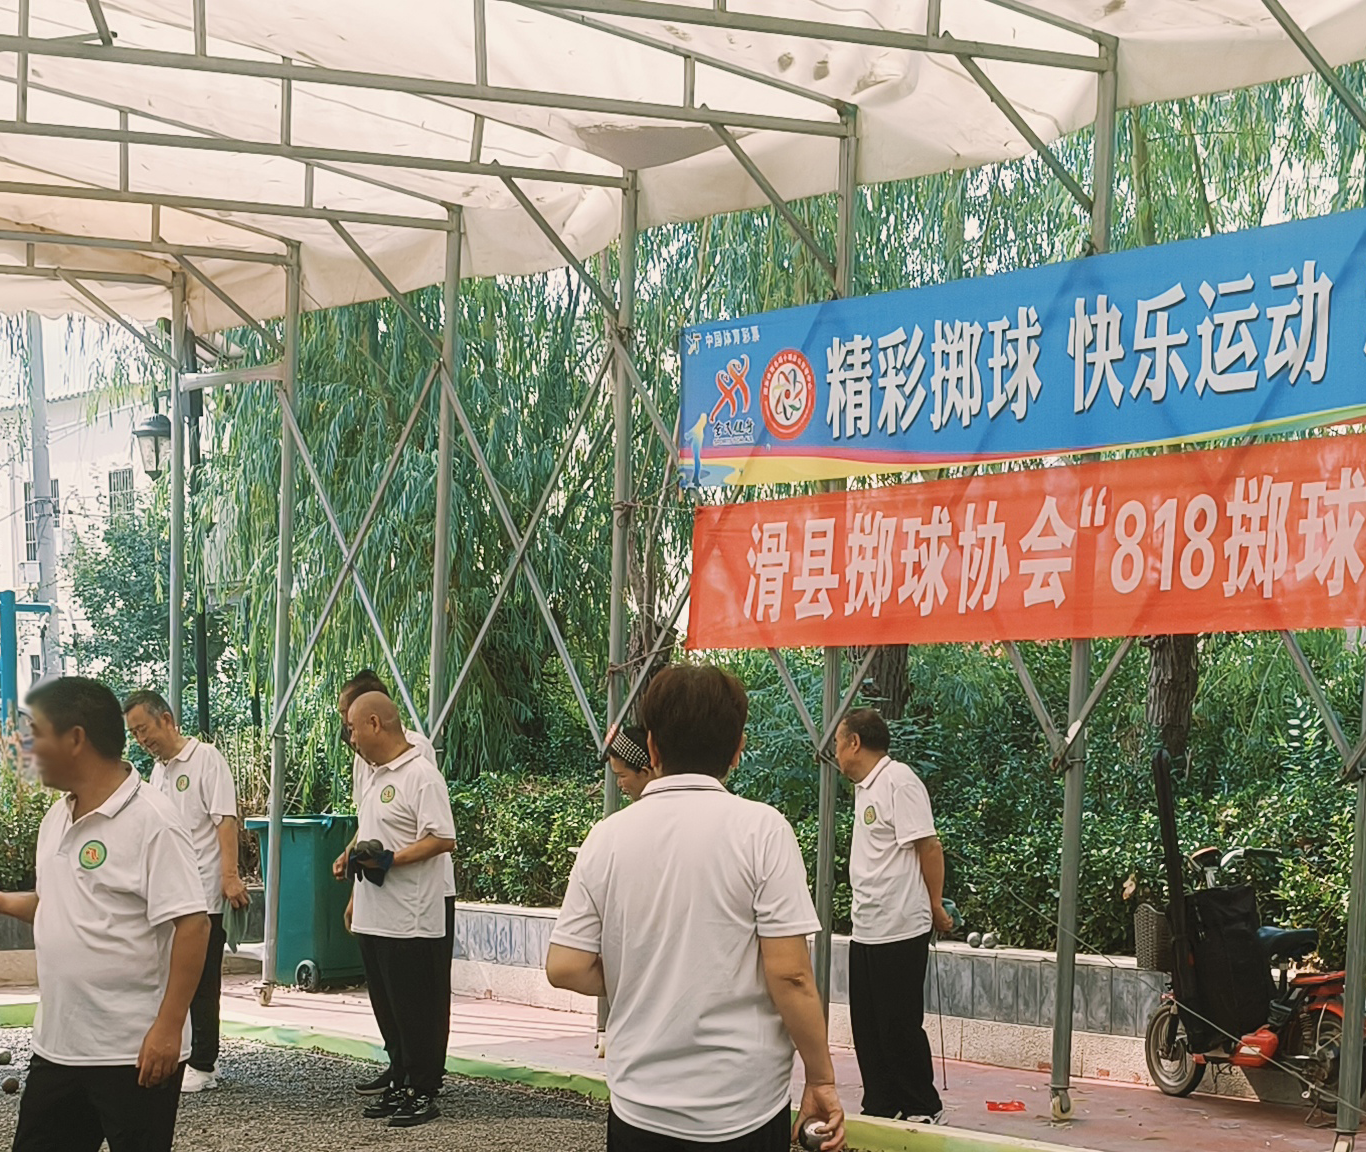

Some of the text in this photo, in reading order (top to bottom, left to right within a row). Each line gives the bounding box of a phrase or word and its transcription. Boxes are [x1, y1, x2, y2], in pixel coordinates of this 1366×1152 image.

[826, 305, 1043, 439] 精彩掷球
[1066, 259, 1334, 414] 快乐运动
